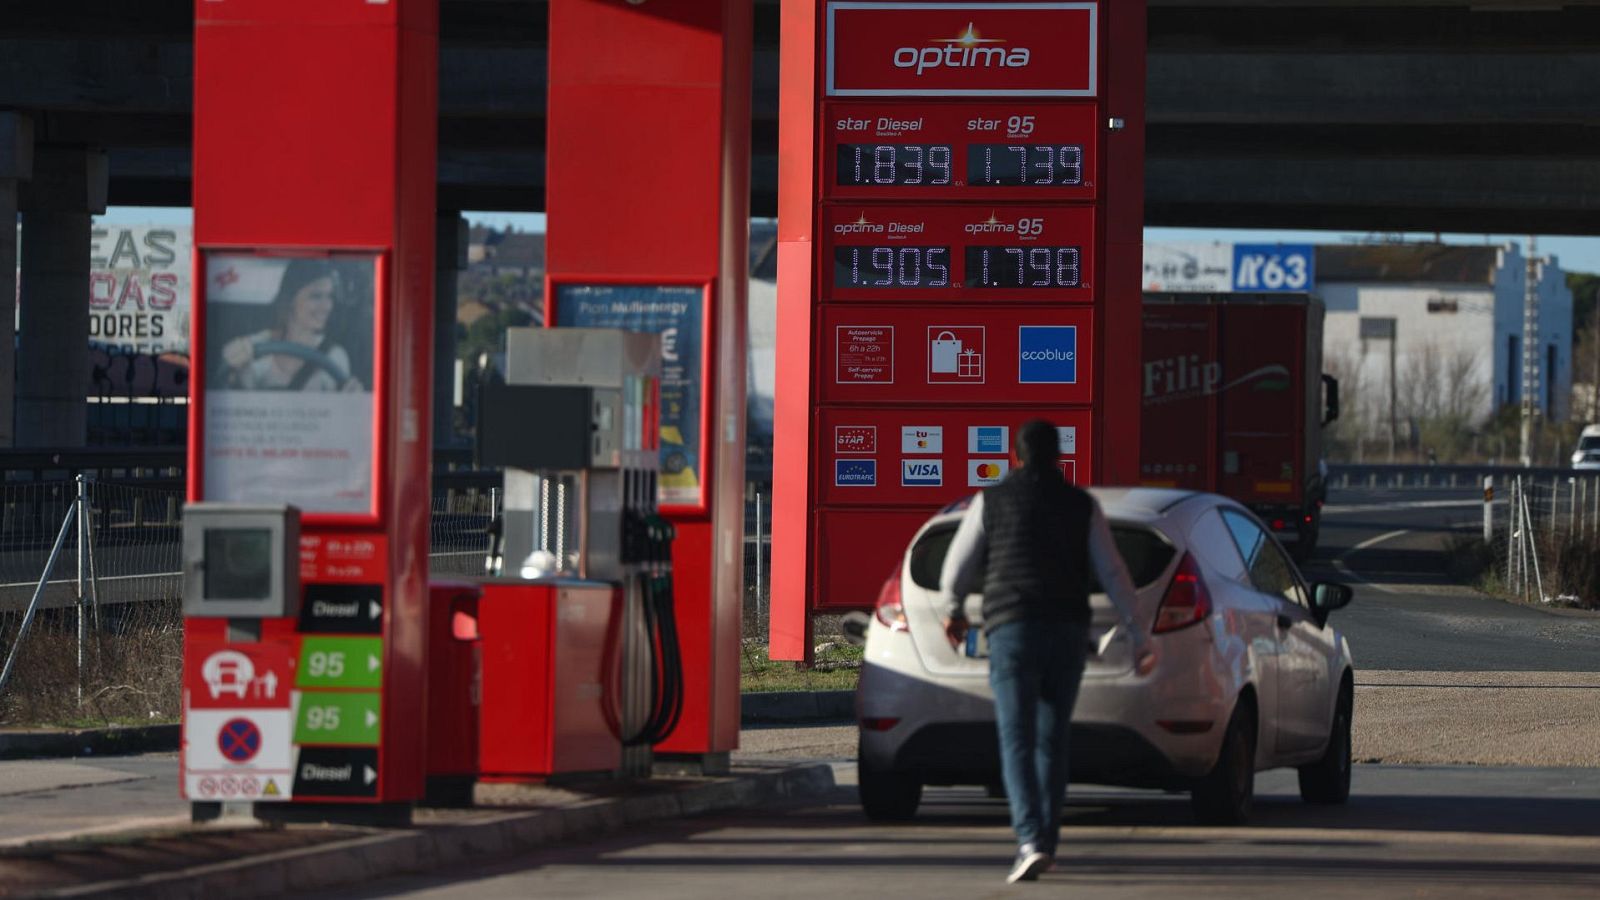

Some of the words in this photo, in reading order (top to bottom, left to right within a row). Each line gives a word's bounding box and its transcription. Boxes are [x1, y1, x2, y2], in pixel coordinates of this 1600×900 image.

[893, 43, 1030, 75] optima
[836, 118, 871, 131] star
[877, 117, 923, 131] Diesel
[967, 118, 1001, 131] star
[1006, 116, 1035, 134] 95
[854, 145, 950, 184] 1.839
[985, 146, 1081, 185] 1.739
[834, 221, 884, 235] optima
[888, 222, 924, 234] Diesel
[964, 221, 1014, 235] optima
[1017, 218, 1043, 235] 95
[852, 247, 948, 286] 1.905
[983, 248, 1079, 286] 1.798
[1021, 349, 1074, 360] ecoblue
[1144, 354, 1222, 397] Filip
[838, 435, 864, 444] STAR
[916, 430, 928, 438] tu
[908, 464, 939, 476] VISA
[312, 600, 359, 617] Diesel
[308, 652, 346, 677] 95
[306, 706, 341, 731] 95
[301, 763, 353, 782] Diesel
